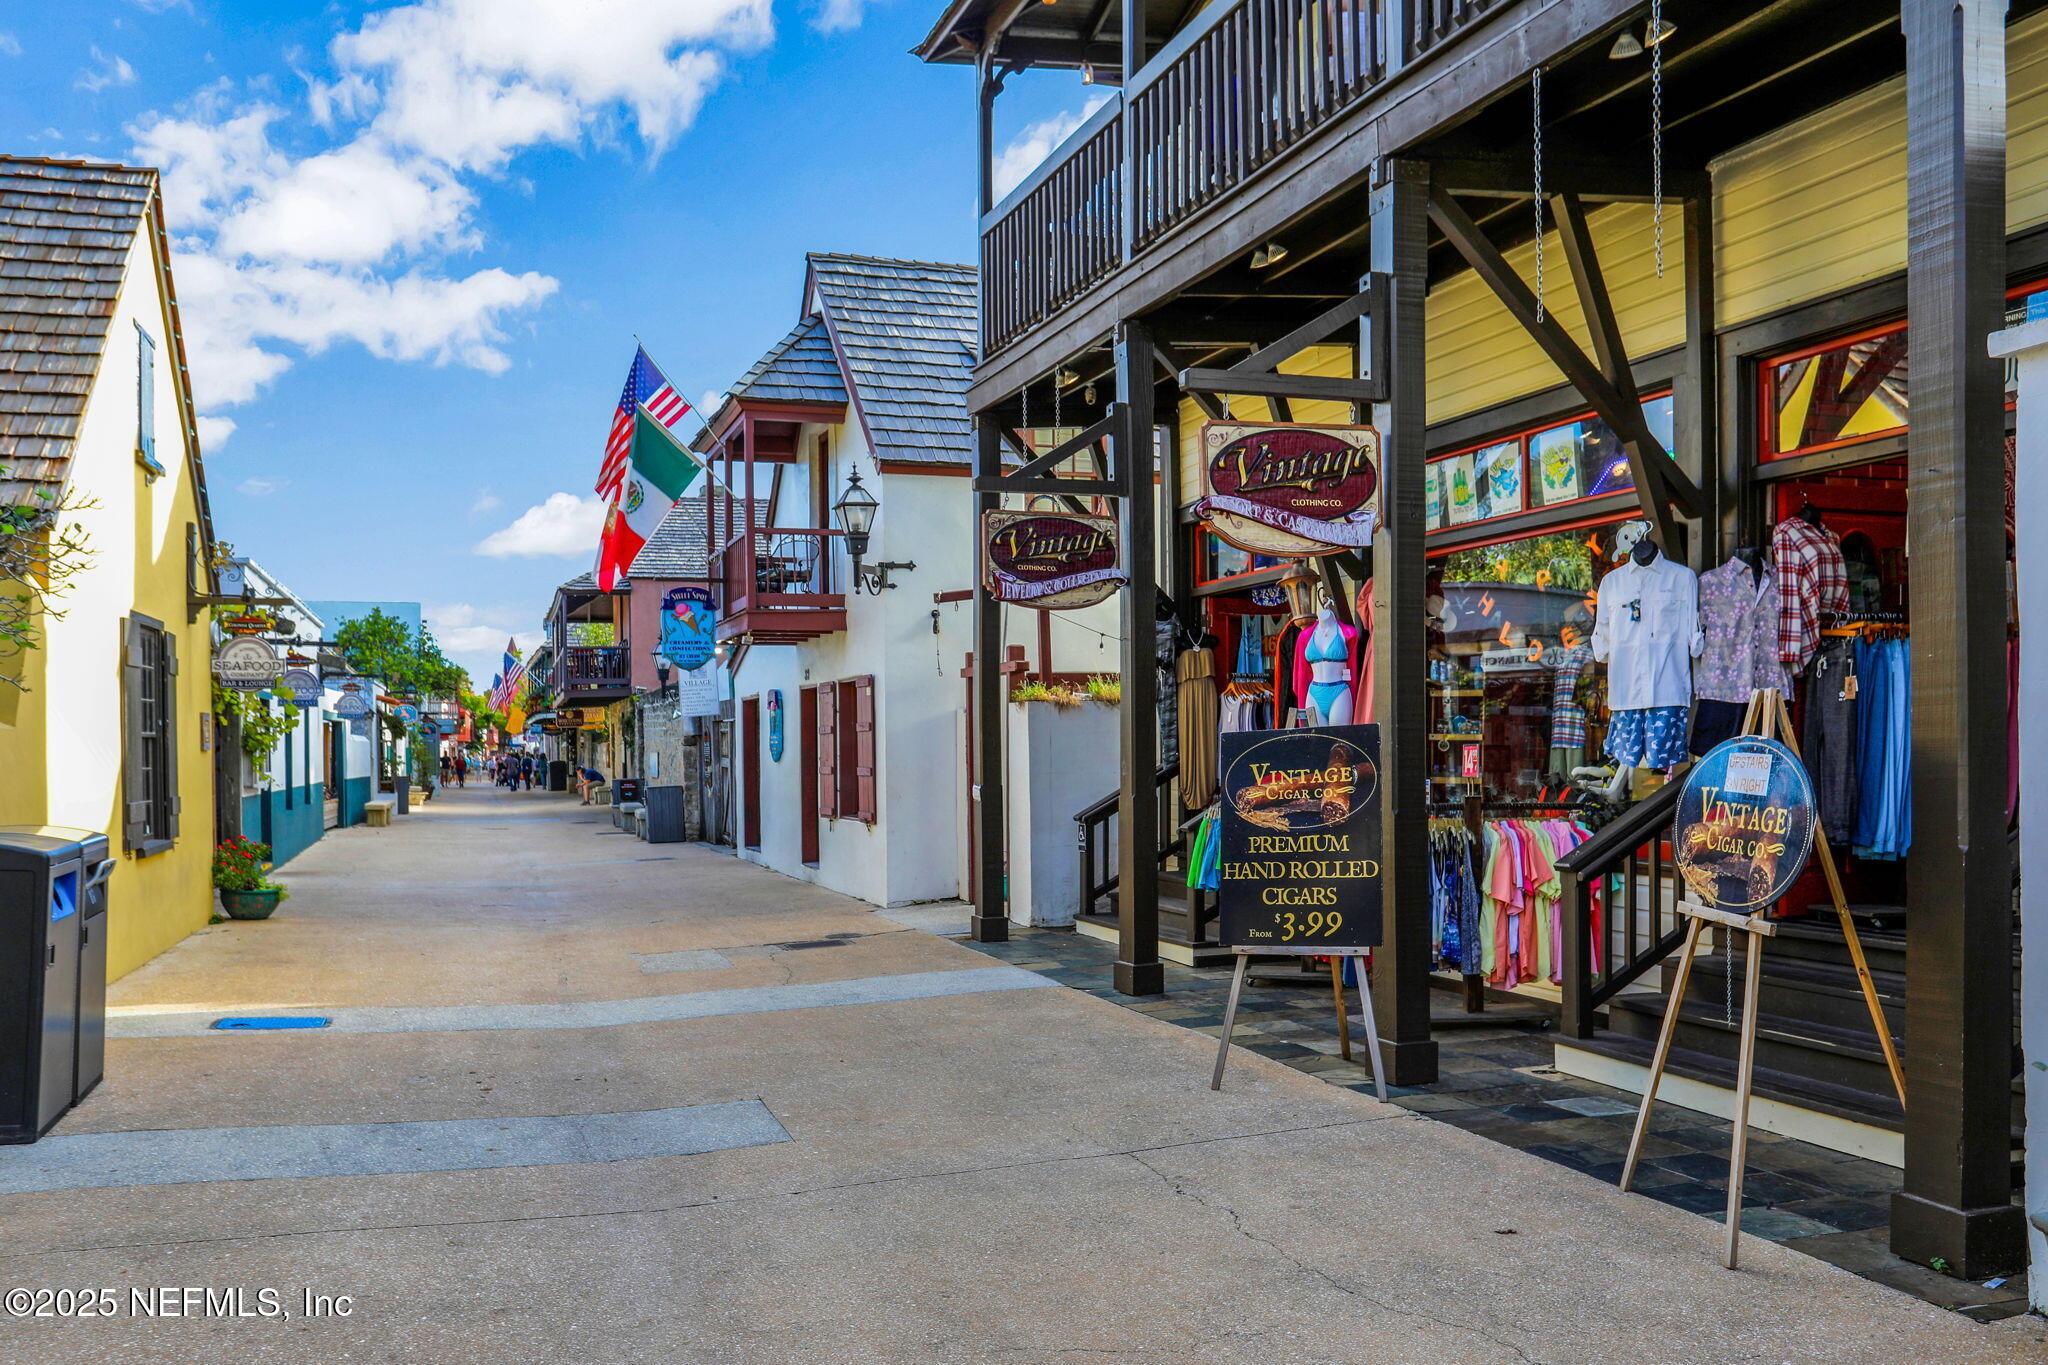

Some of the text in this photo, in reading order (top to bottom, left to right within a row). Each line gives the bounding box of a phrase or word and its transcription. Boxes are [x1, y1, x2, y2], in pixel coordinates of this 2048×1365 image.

[1217, 441, 1372, 493] Vintage
[1291, 498, 1343, 507] CLOTHING CO.
[1264, 509, 1275, 523] &
[994, 525, 1112, 564] Vintage
[1017, 564, 1047, 572] CLOTHING
[213, 661, 281, 672] SEAFOOD
[684, 679, 712, 687] VILLAGE
[1729, 755, 1770, 769] UPSTAIRS
[1250, 763, 1353, 786] VINTAGE
[1264, 786, 1337, 800] CIGAR CO.
[1739, 778, 1767, 793] RIGHT
[1701, 786, 1788, 835] VINTAGE
[1248, 834, 1349, 854] PREMIUM
[1706, 827, 1767, 859] CIGAR CO.
[1223, 860, 1379, 880] HAND ROLLED
[1262, 887, 1338, 905] CIGARS
[1274, 911, 1343, 942] $3.99
